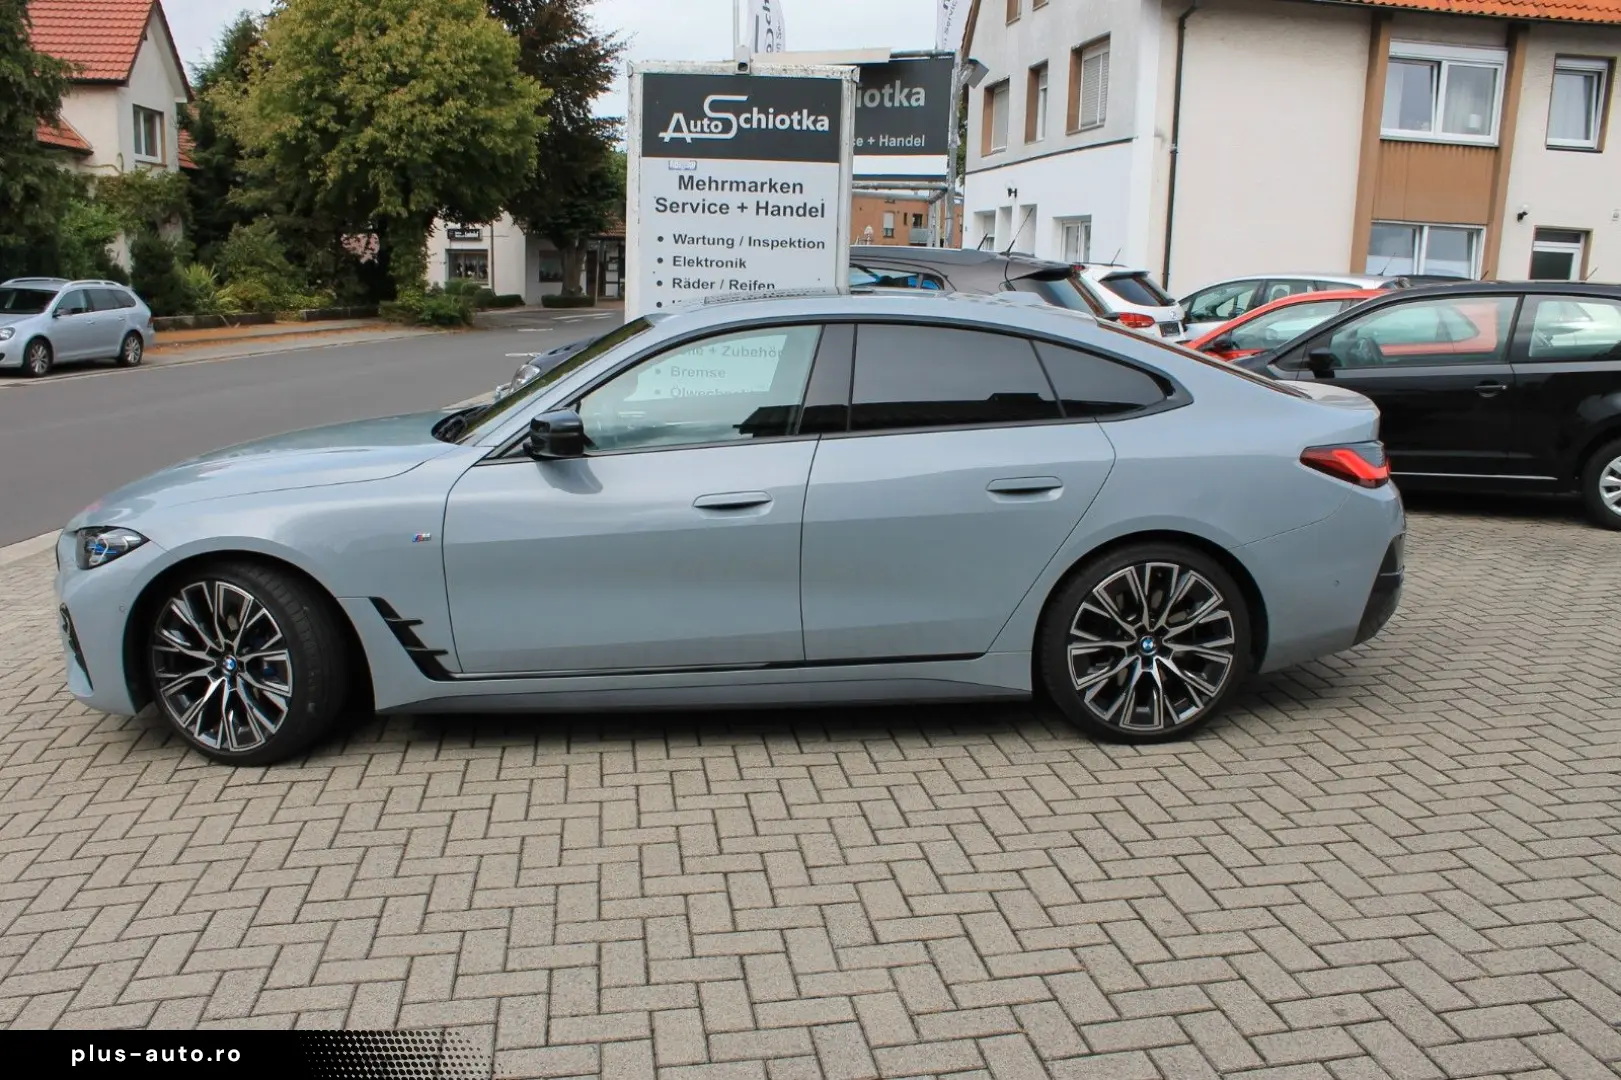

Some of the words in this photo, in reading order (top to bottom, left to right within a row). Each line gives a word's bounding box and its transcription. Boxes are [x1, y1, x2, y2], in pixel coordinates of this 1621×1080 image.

[856, 80, 926, 108] iotka
[658, 112, 723, 143] Auto
[879, 134, 926, 147] Handel
[678, 174, 804, 194] Mehrmarken
[654, 196, 730, 215] Service
[737, 202, 748, 213] +
[755, 199, 826, 218] Handel
[672, 233, 735, 249] Wartung
[739, 236, 744, 247] /
[748, 236, 826, 250] Inspektion
[672, 255, 747, 269] Elektronik
[672, 277, 716, 290] Räder
[719, 279, 725, 290] /
[728, 279, 776, 291] Reifen
[670, 365, 727, 379] Bremse
